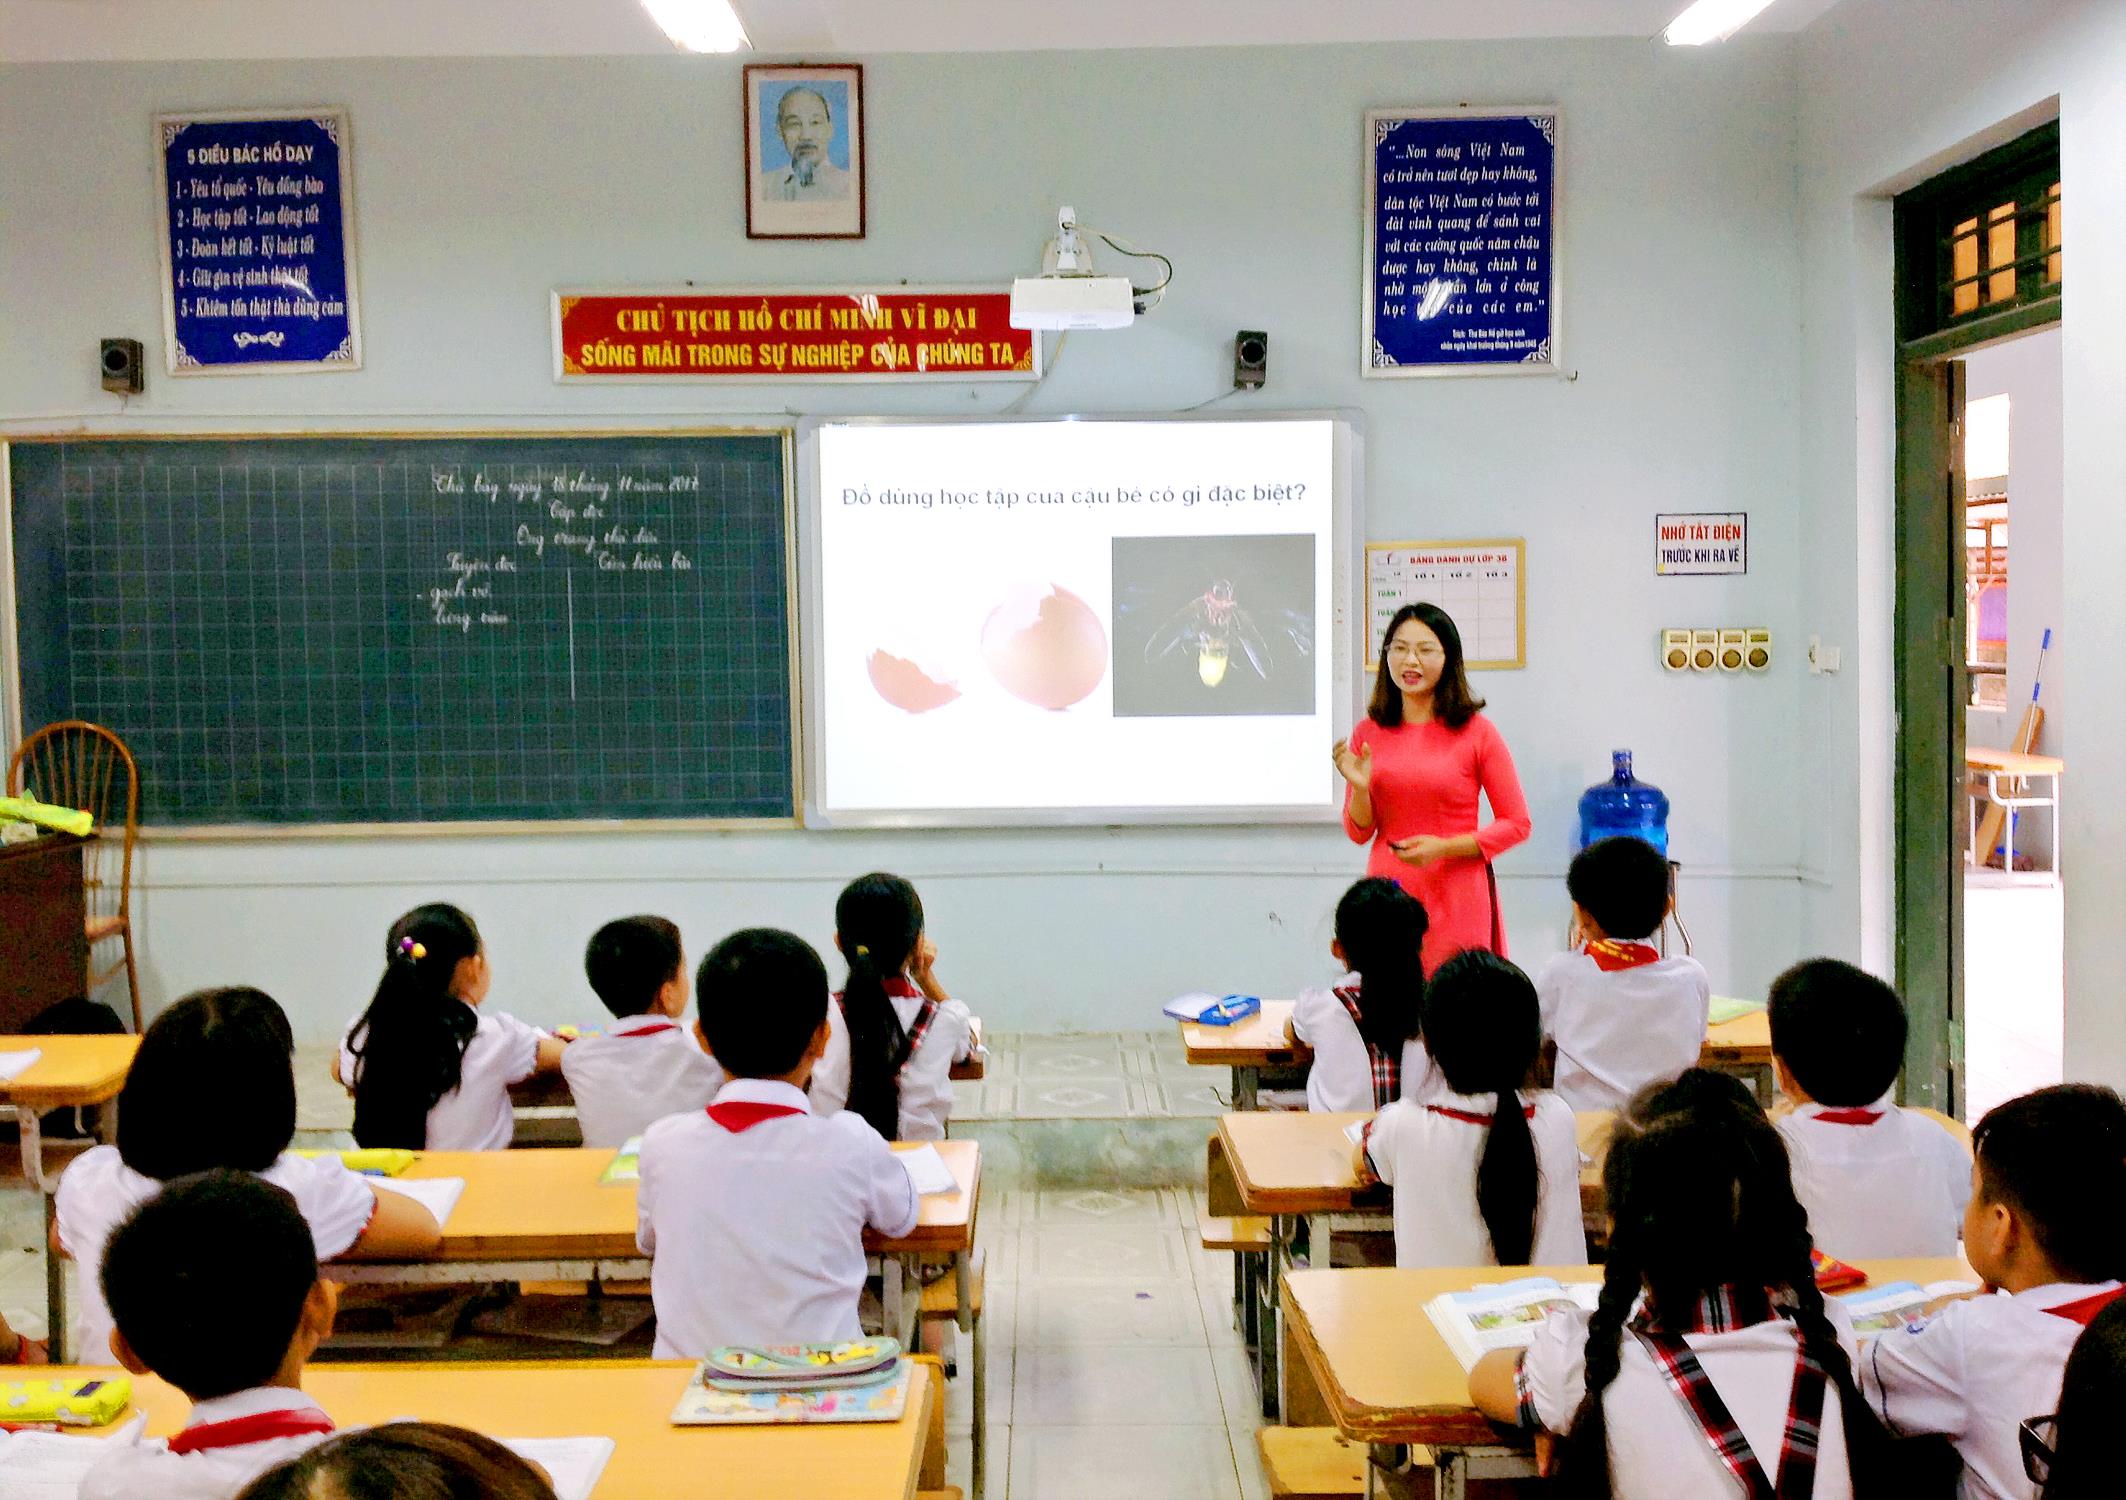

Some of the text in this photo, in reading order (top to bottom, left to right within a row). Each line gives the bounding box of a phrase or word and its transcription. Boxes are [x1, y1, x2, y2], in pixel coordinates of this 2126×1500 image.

[188, 148, 194, 165] 5
[233, 142, 260, 163] BÁC
[264, 140, 282, 162] HỒ
[285, 145, 314, 164] DẠY
[1436, 144, 1460, 160] sông
[1470, 143, 1491, 161] Việt
[1500, 142, 1525, 157] Nam
[1383, 172, 1395, 184] có
[1416, 170, 1434, 182] nên
[1460, 167, 1479, 185] đẹp
[1482, 166, 1501, 183] hay
[190, 178, 208, 198] Yêu
[256, 176, 274, 196] Yêu
[1384, 196, 1404, 211] dân
[1409, 196, 1424, 214] tộc
[1429, 194, 1449, 212] Việt
[1453, 194, 1478, 208] Nam
[1482, 194, 1494, 208] có
[177, 209, 184, 228] 2
[192, 208, 211, 231] Học
[256, 206, 275, 225] Lao
[1386, 216, 1404, 232] đài
[1438, 216, 1471, 233] quang
[1493, 214, 1519, 228] sánh
[1524, 214, 1541, 227] vai
[177, 239, 183, 258] 3
[1404, 240, 1422, 253] các
[1488, 238, 1511, 250] năm
[1514, 234, 1540, 250] châu
[1416, 259, 1436, 276] hay
[1488, 258, 1518, 272] chính
[1526, 256, 1537, 271] là
[178, 270, 184, 288] 4
[246, 266, 268, 286] sinh
[1515, 280, 1539, 296] công
[182, 299, 188, 318] 5
[616, 298, 976, 338] CHỦ TỊCH HỒ CHÍ MINH VĨ ĐẠI
[1384, 300, 1406, 318] học
[1449, 298, 1473, 315] của
[1483, 300, 1506, 314] các
[580, 336, 1014, 372] SỐNG MÃI TRONG SỰ NGHIỆP CỦA CHÚNG TA
[940, 488, 978, 510] học
[986, 488, 1019, 509] tập
[1072, 488, 1110, 509] cậu
[1662, 520, 1741, 542] NHỚ TẮT ĐIỆN
[1662, 544, 1740, 563] TRƯỚC KHI RA VỀ
